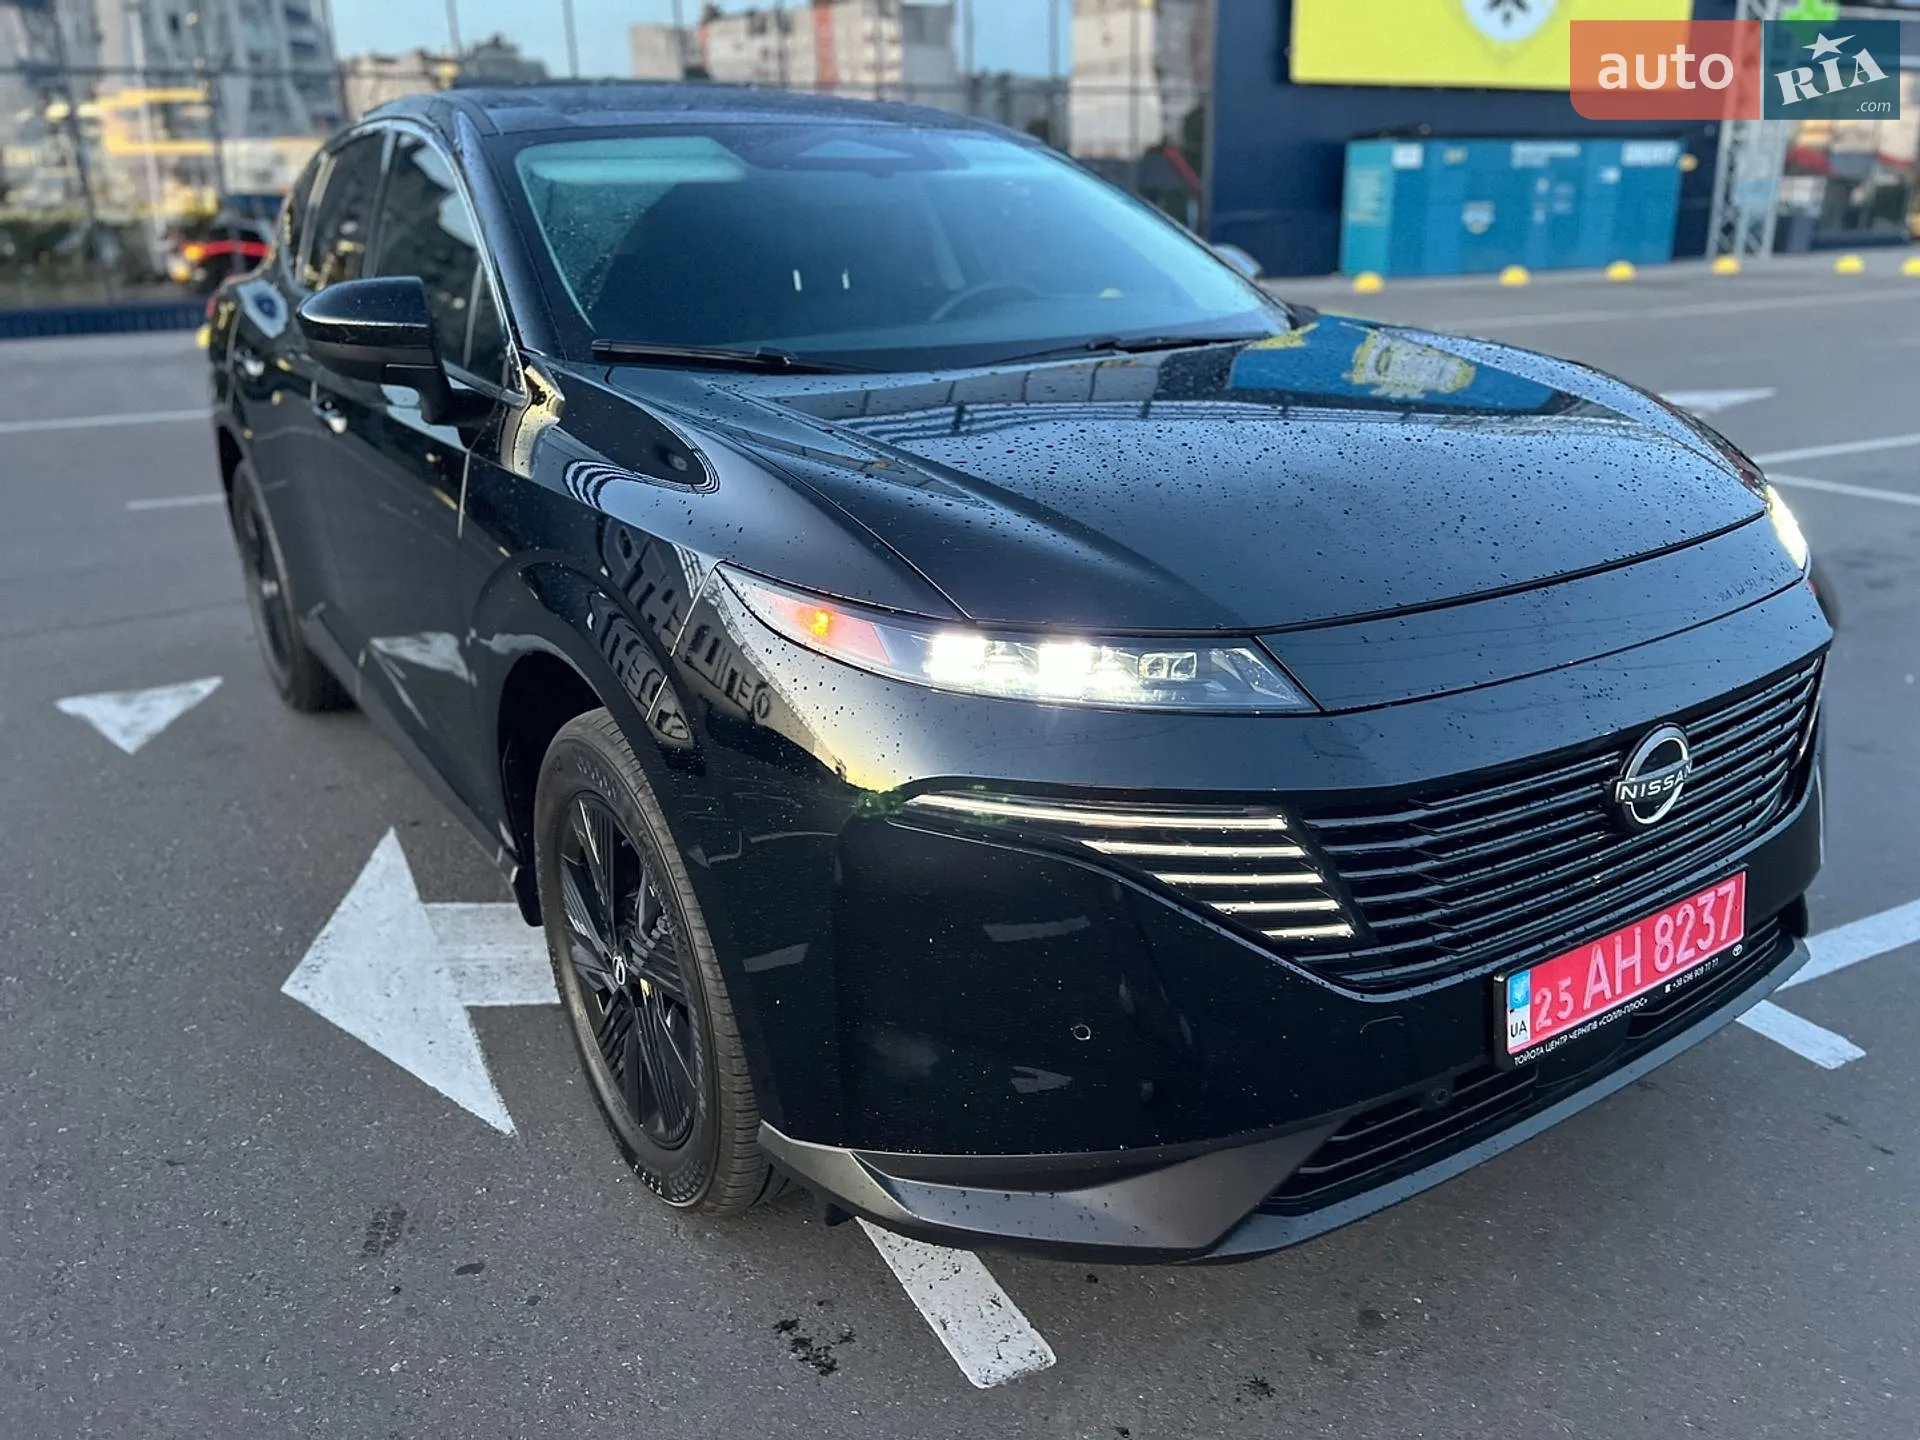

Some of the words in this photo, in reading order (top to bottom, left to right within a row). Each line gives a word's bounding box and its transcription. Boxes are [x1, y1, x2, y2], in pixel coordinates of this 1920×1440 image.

[1620, 760, 1692, 800] NISSAN
[1534, 976, 1574, 1033] 25
[1583, 925, 1642, 1011] AH
[1654, 880, 1737, 974] 8237
[1510, 1020, 1528, 1038] UA
[1545, 1034, 1568, 1053] ЦЕНТР
